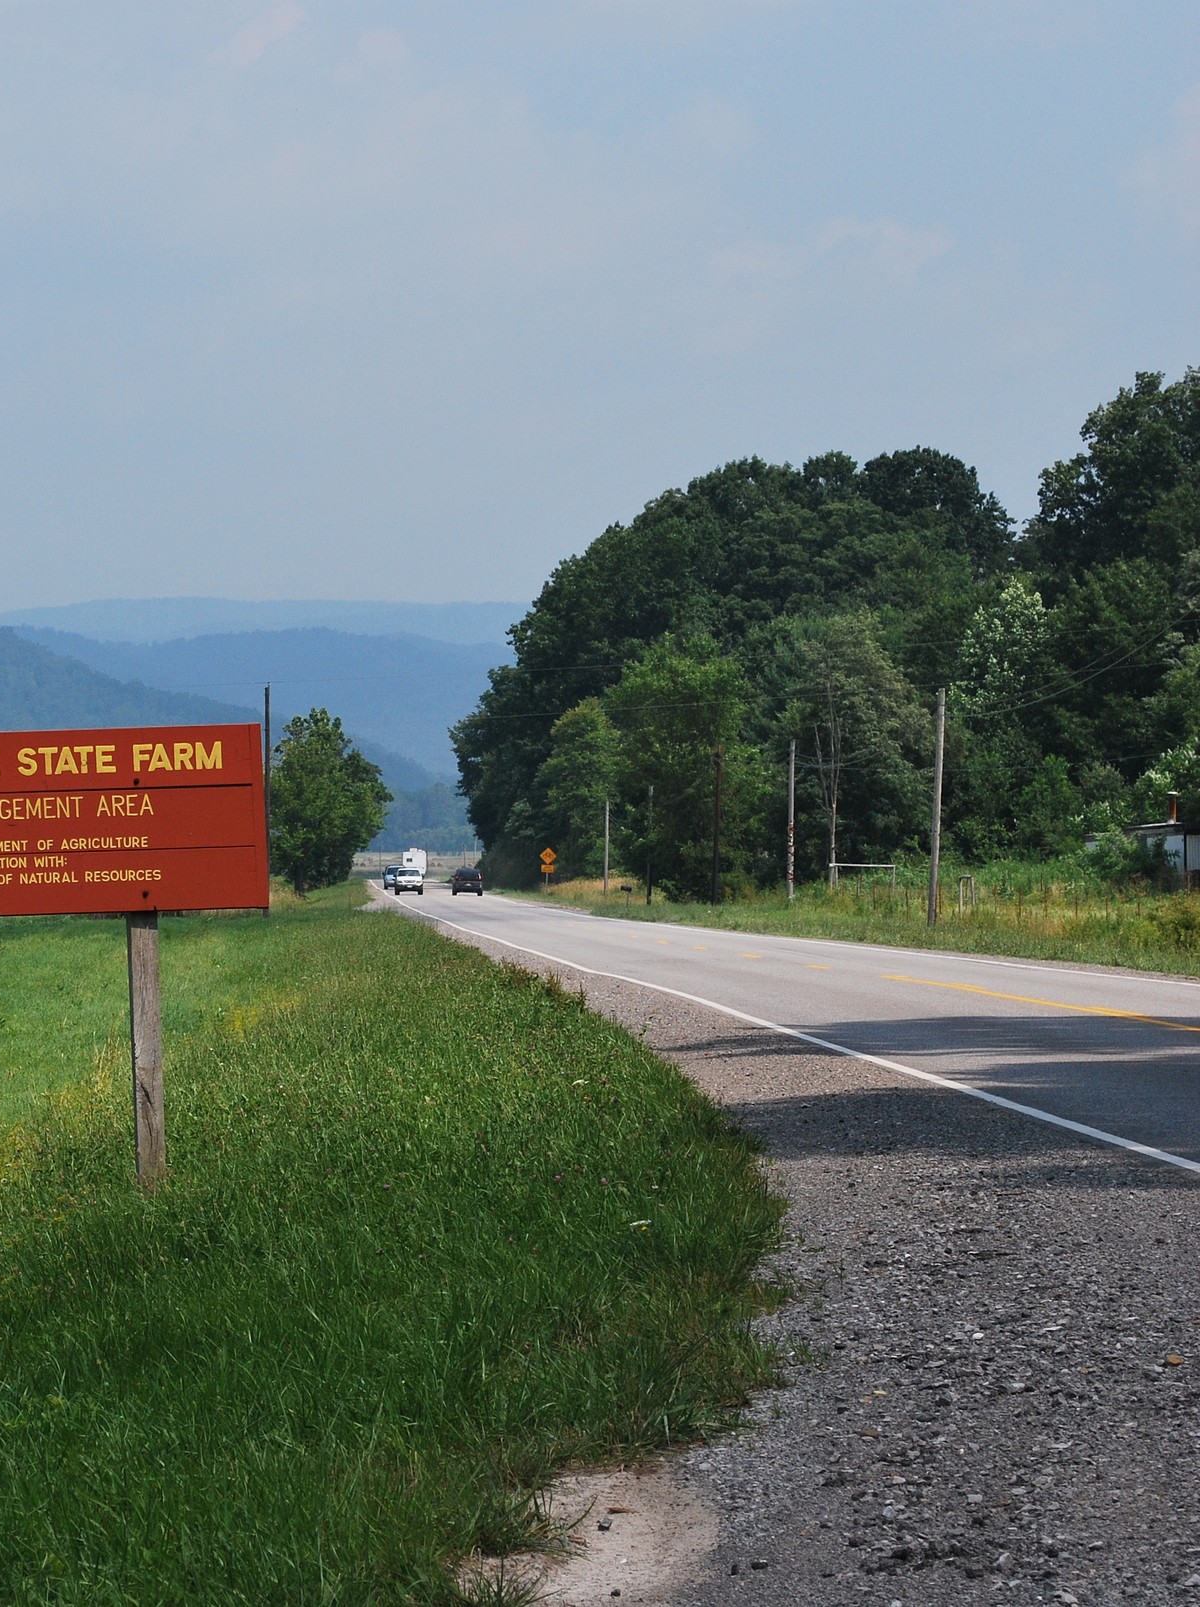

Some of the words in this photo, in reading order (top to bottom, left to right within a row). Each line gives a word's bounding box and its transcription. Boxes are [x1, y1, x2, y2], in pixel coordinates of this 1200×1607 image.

[17, 744, 117, 777] STATE
[132, 740, 223, 772] FARM
[96, 793, 154, 818] AREA
[37, 839, 54, 851] OF
[60, 836, 149, 850] AGRICULTURE
[33, 855, 68, 868] WITH:
[19, 871, 79, 885] NATURAL
[84, 869, 162, 883] RESOURCES
